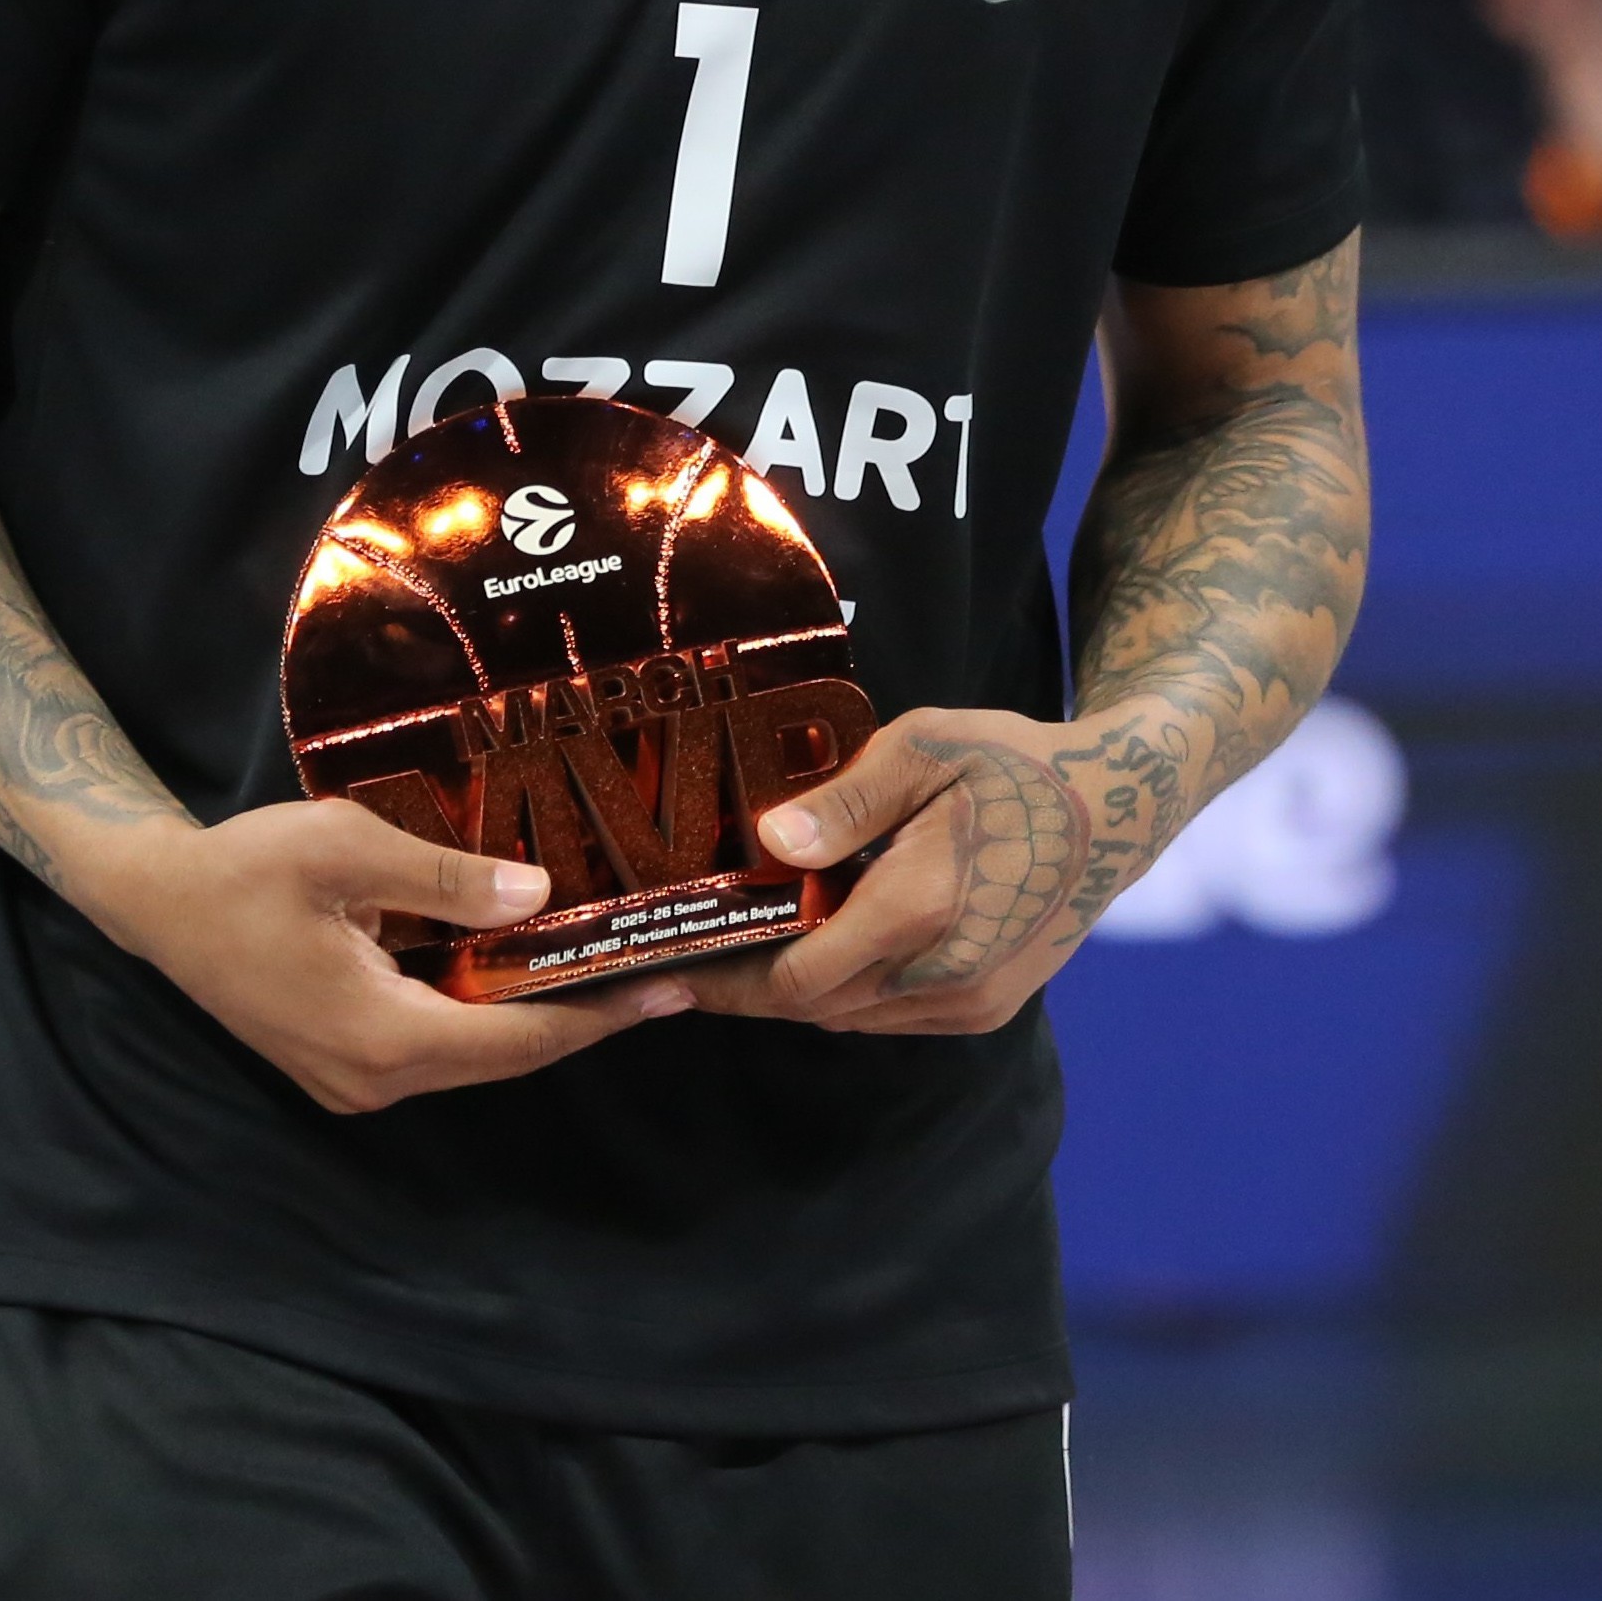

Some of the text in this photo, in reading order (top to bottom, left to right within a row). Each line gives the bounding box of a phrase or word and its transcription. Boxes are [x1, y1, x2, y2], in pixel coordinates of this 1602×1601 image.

[661, 2, 759, 287] 1
[483, 551, 623, 600] EuroLeague
[459, 639, 739, 758] MARCH
[347, 678, 881, 951] MVP
[528, 947, 577, 972] CARLIK
[578, 938, 622, 963] JONES
[629, 925, 679, 947] Partizan
[679, 917, 728, 936] Mozzart
[728, 910, 749, 925] Bet
[750, 901, 797, 921] Belgrade
[610, 897, 719, 931] 2025-26 Season
